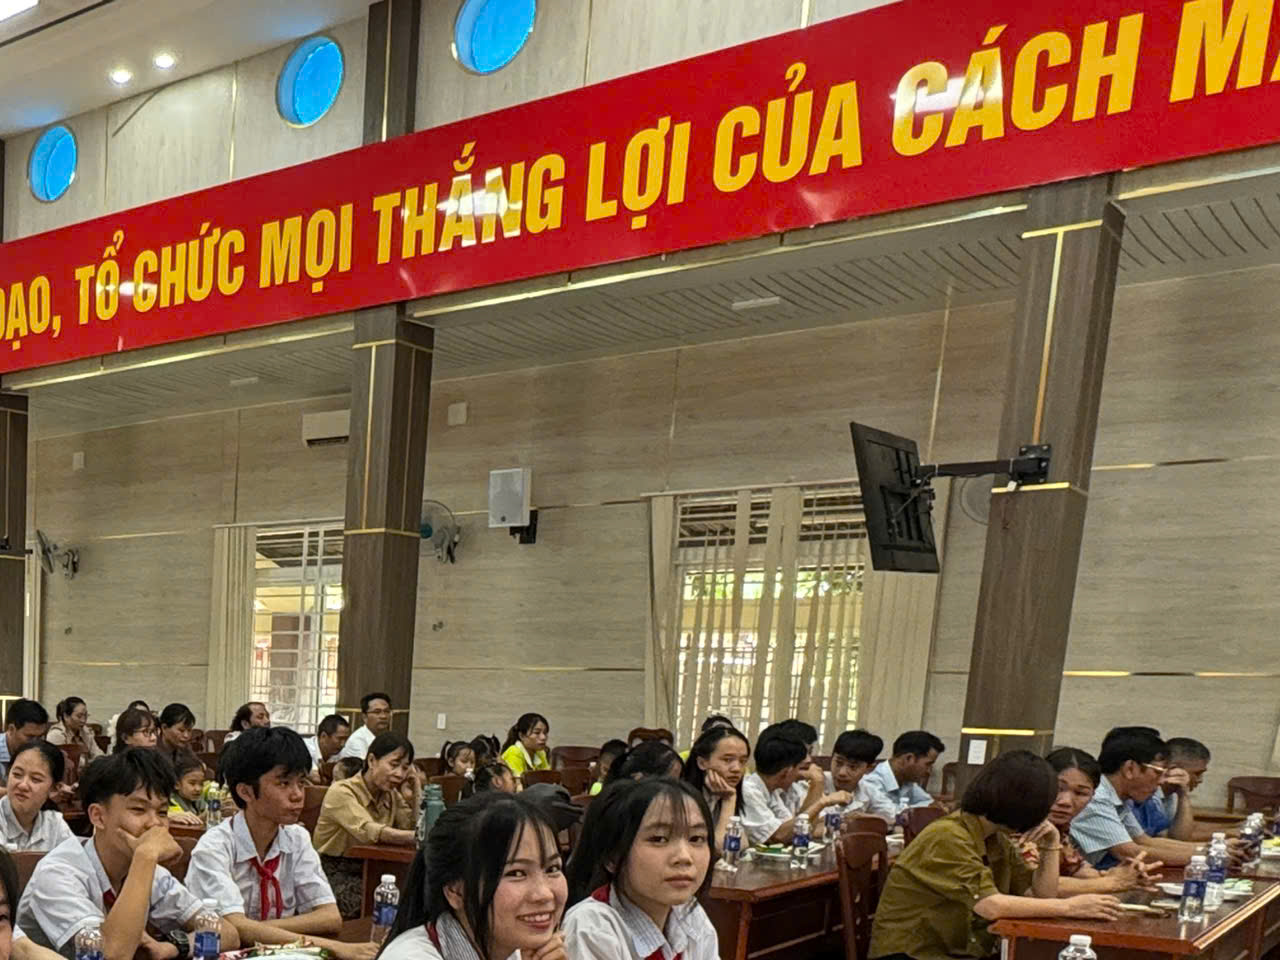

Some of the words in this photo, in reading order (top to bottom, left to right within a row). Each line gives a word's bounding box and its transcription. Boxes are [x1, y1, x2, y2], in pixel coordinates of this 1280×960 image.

[75, 229, 125, 325] TỔ
[132, 221, 246, 313] CHỨC
[259, 203, 354, 294] MỌI
[373, 140, 566, 265] THẮNG
[585, 115, 692, 231] LỢI
[712, 62, 863, 194] CỦA
[891, 13, 1145, 157] CÁCH
[1169, 0, 1280, 104] M
